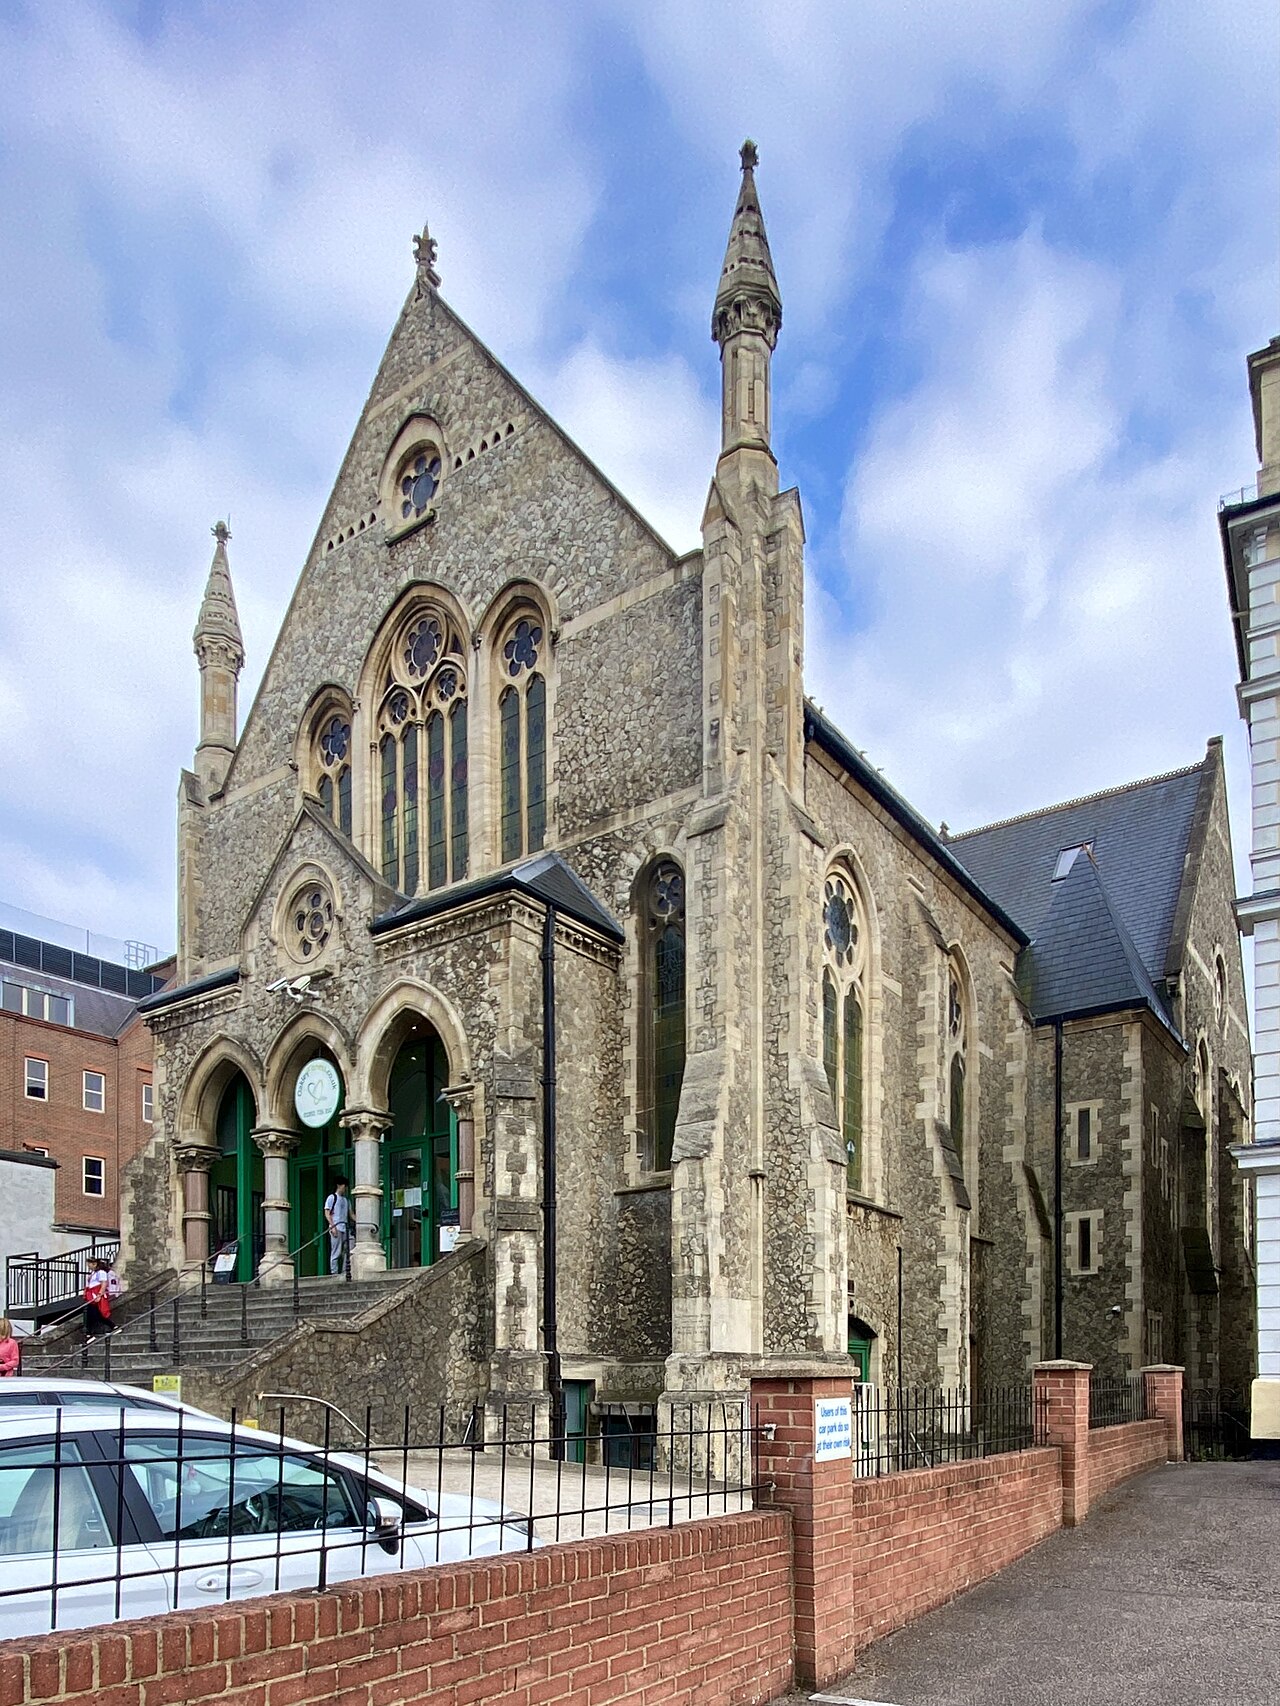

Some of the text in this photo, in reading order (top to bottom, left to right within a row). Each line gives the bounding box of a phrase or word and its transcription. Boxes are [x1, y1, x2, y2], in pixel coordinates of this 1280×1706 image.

[820, 1406, 834, 1417] Users
[835, 1406, 839, 1416] of
[827, 1422, 837, 1435] park
[838, 1422, 843, 1432] do
[844, 1423, 849, 1431] so
[823, 1439, 833, 1450] their
[834, 1440, 842, 1448] own
